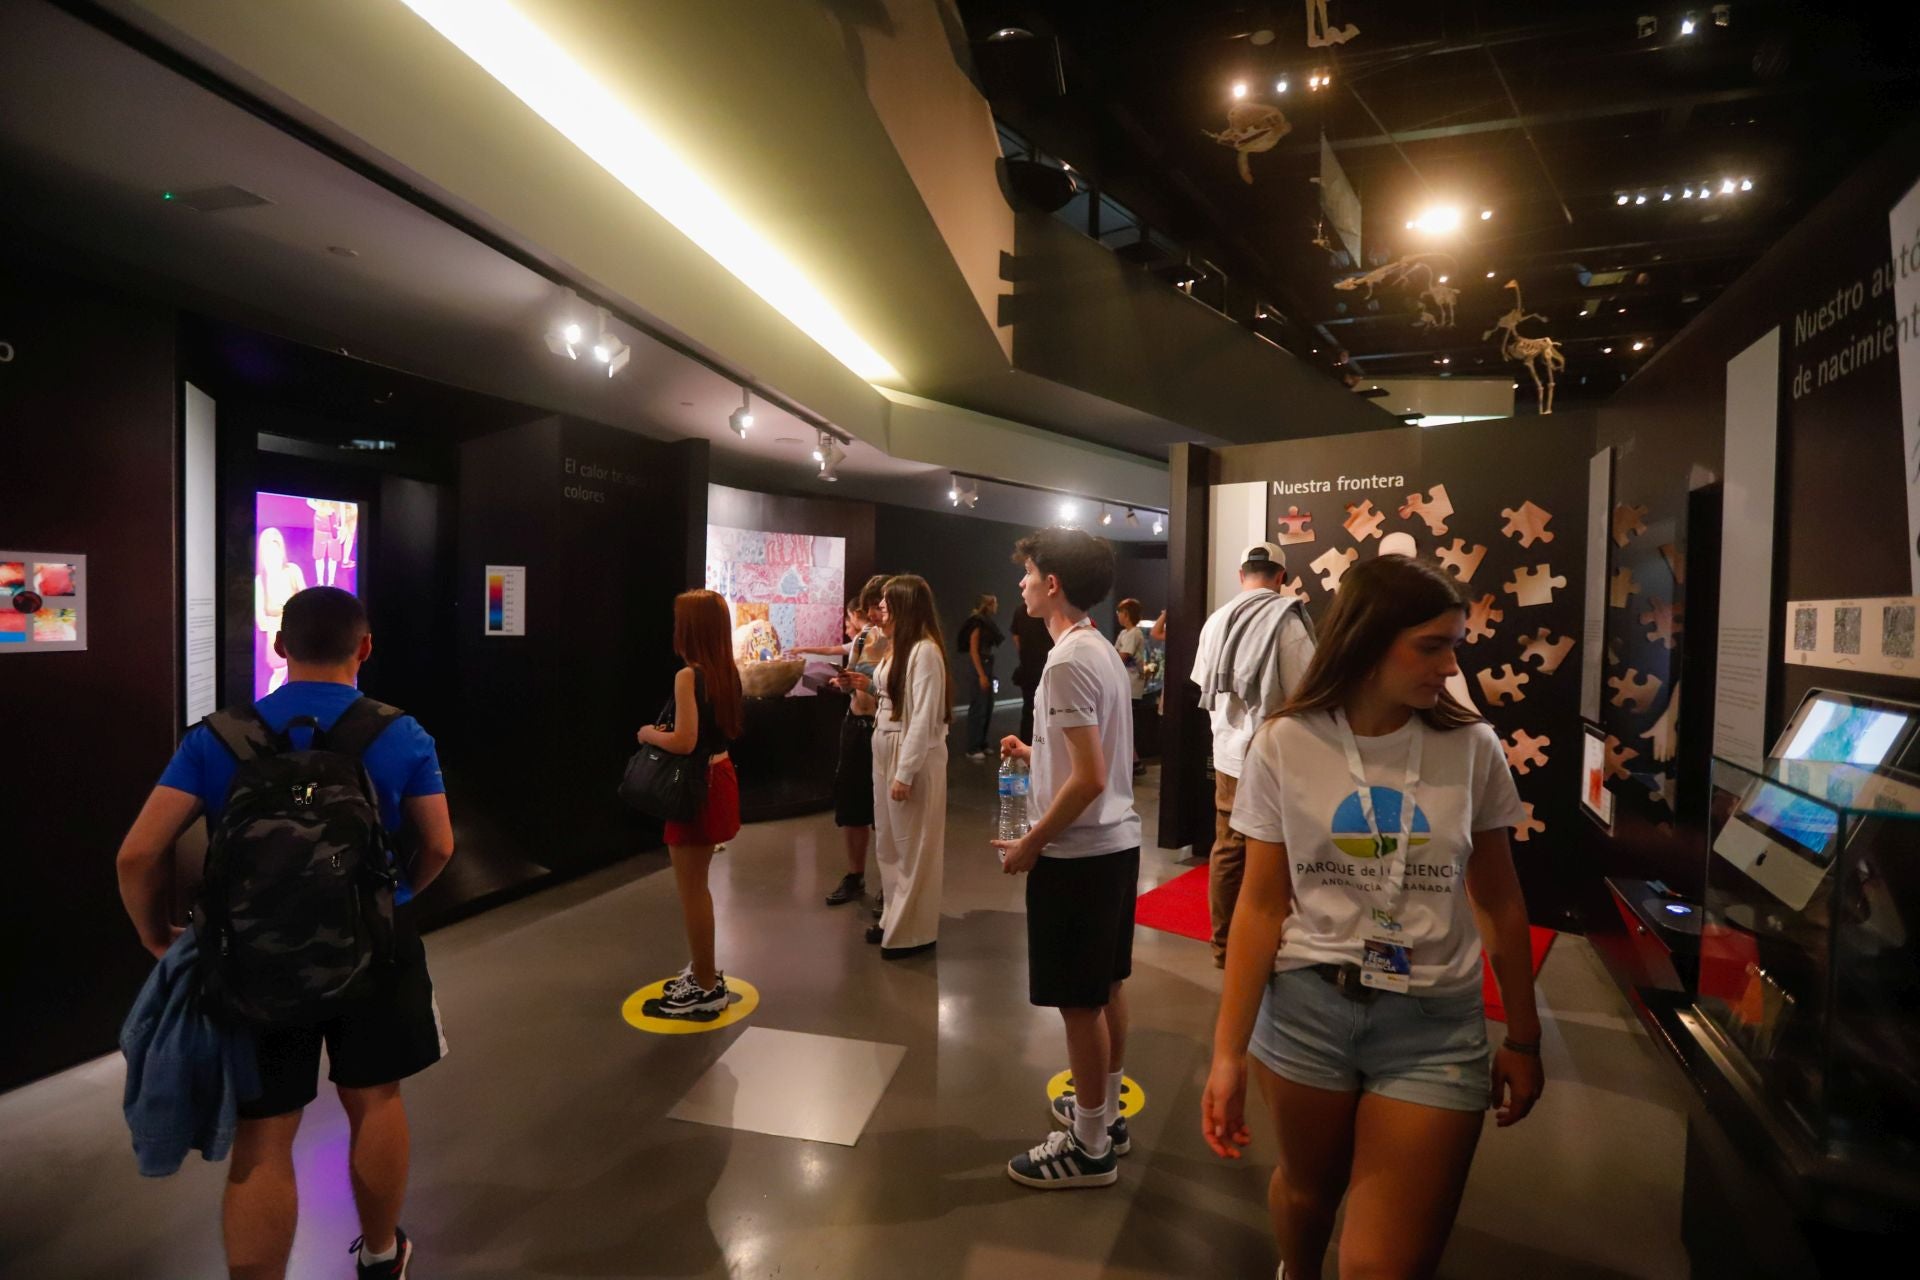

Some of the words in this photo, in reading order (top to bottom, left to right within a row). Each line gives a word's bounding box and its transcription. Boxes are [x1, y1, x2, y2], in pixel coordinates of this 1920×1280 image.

[1795, 281, 1865, 347] Nuestro
[1793, 365, 1812, 400] de
[564, 457, 576, 474] El
[580, 464, 609, 481] calor
[564, 484, 606, 504] colores
[1273, 479, 1331, 496] Nuestra
[1336, 475, 1405, 491] frontera
[1296, 860, 1356, 877] PARQUE
[1360, 865, 1376, 877] de
[1402, 882, 1452, 893] RANADA
